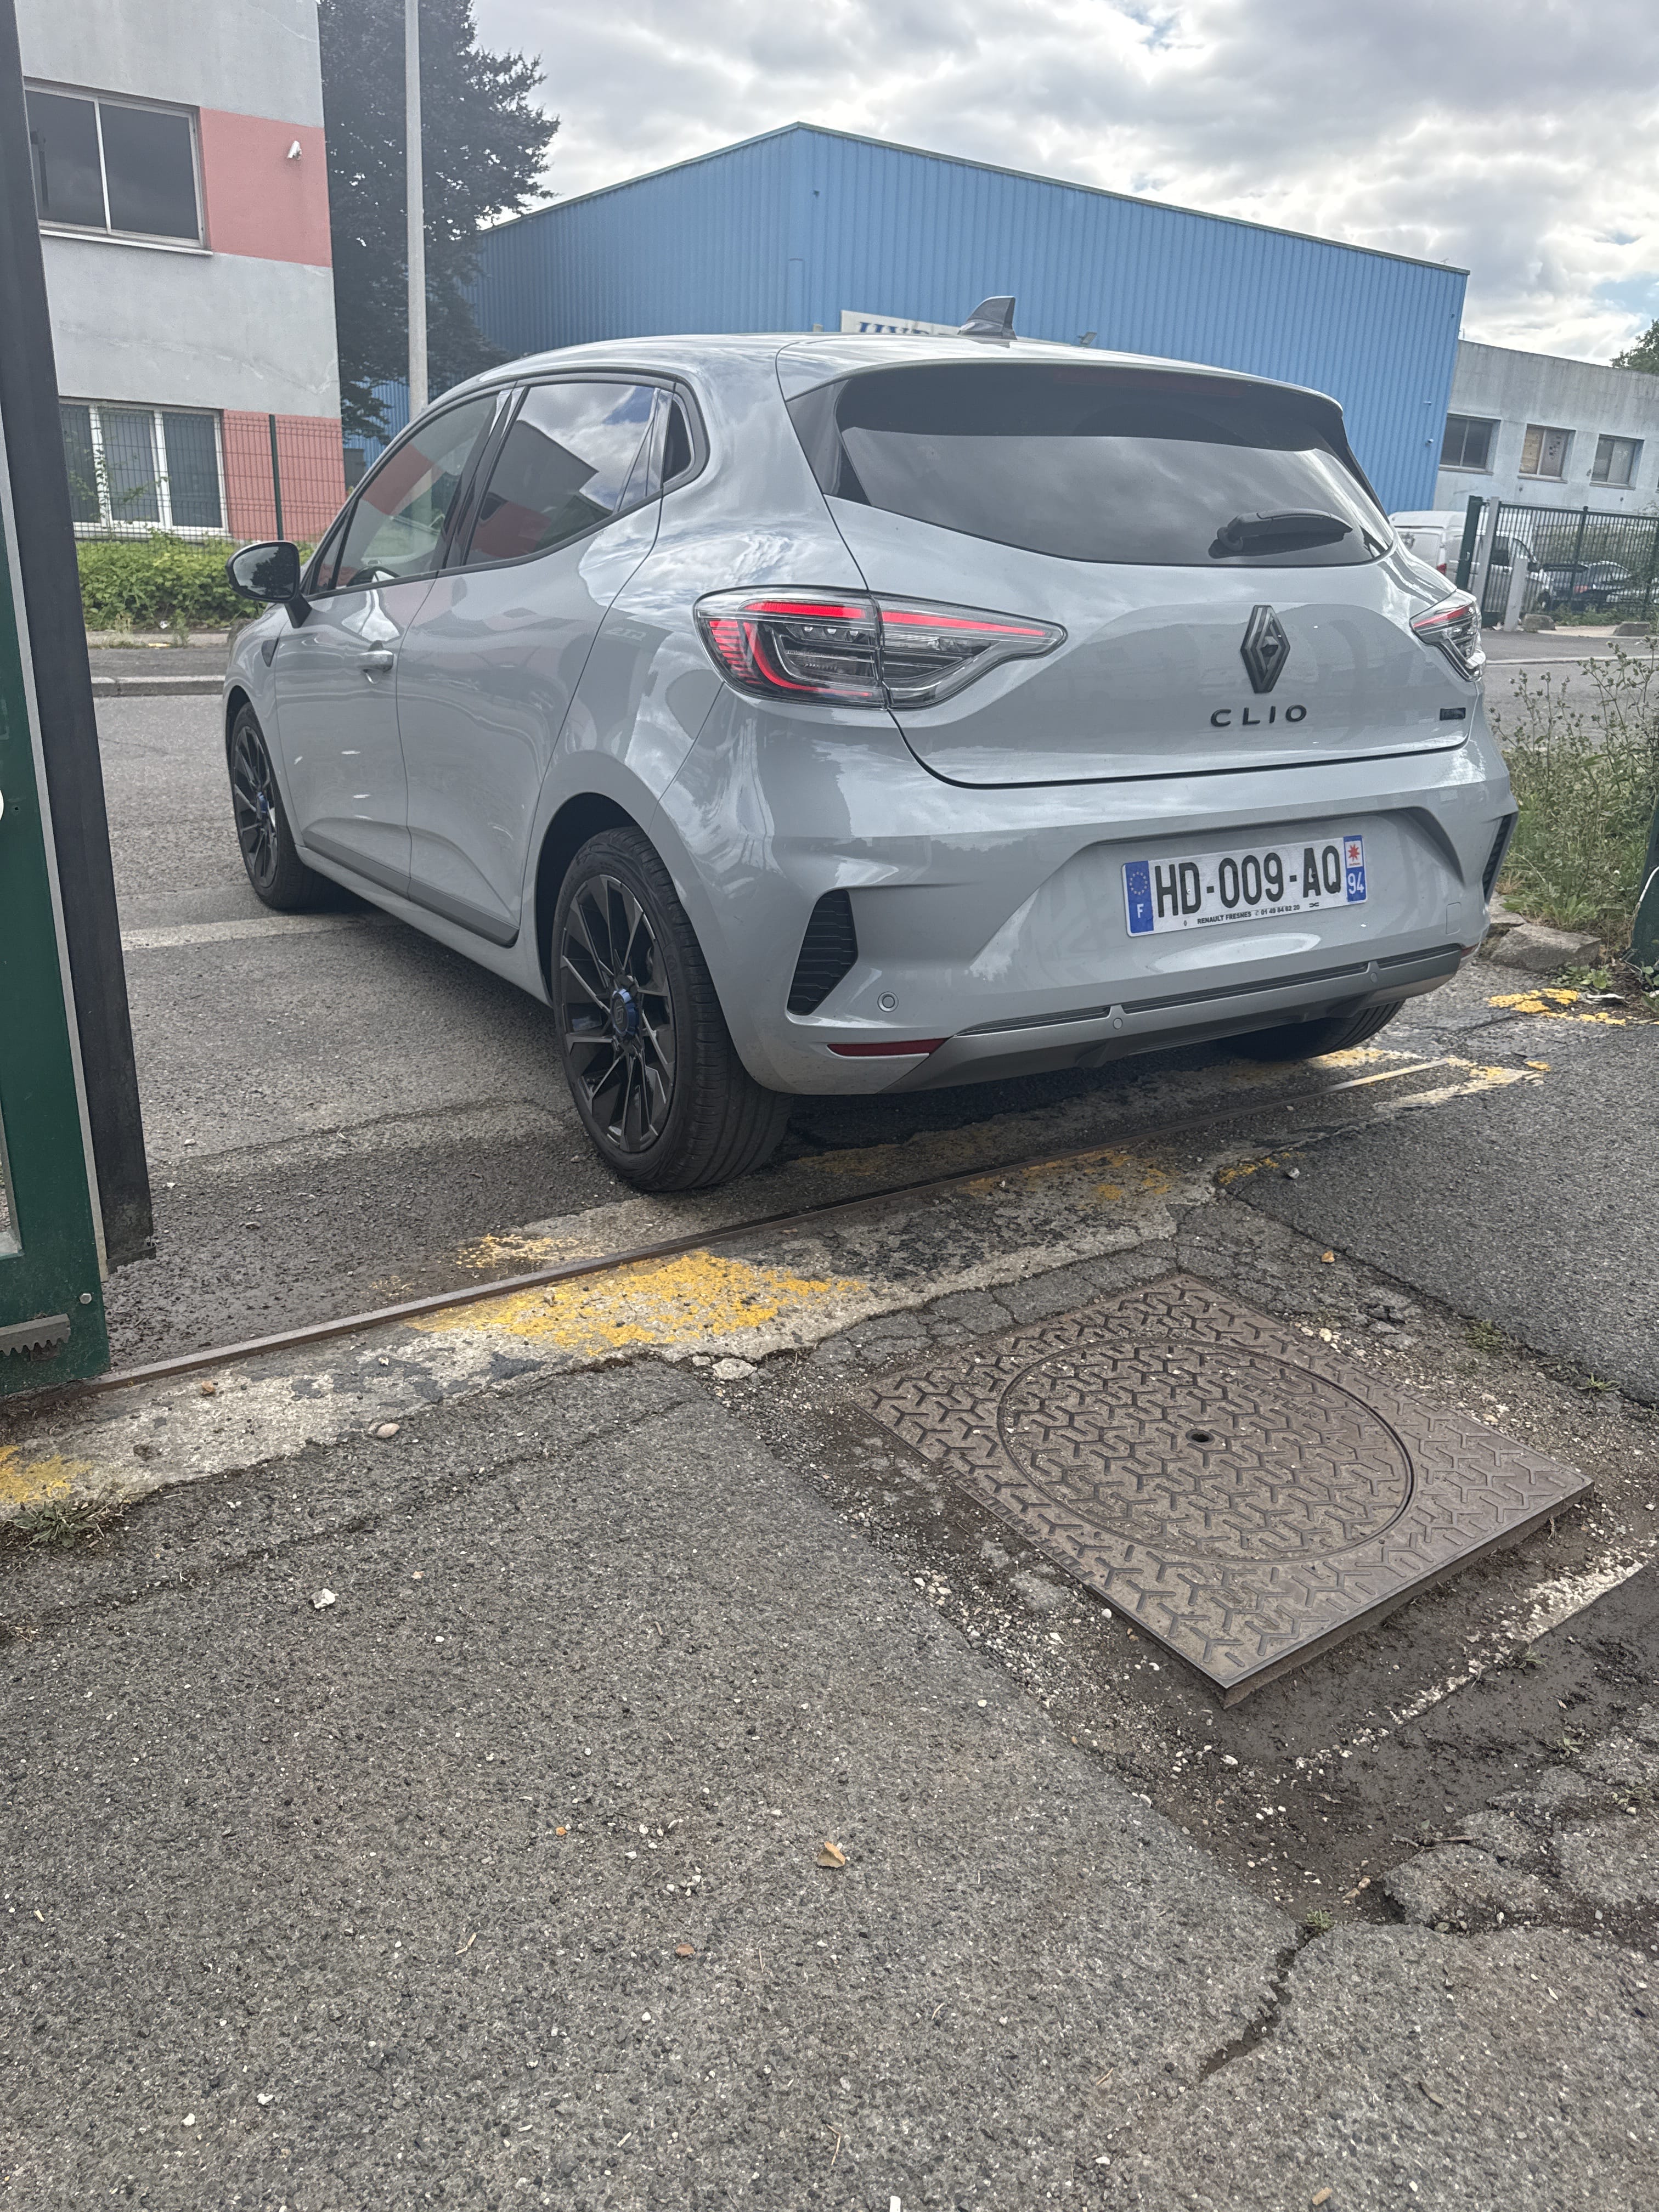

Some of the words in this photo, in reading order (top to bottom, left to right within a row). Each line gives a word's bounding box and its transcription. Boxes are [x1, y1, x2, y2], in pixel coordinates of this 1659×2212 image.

[1210, 704, 1307, 727] CLIO
[1155, 845, 1341, 918] HD-009-AQ
[1348, 872, 1364, 894] 94
[1137, 904, 1144, 918] F
[1197, 915, 1224, 924] RENAULT
[1225, 911, 1251, 921] FRESNES
